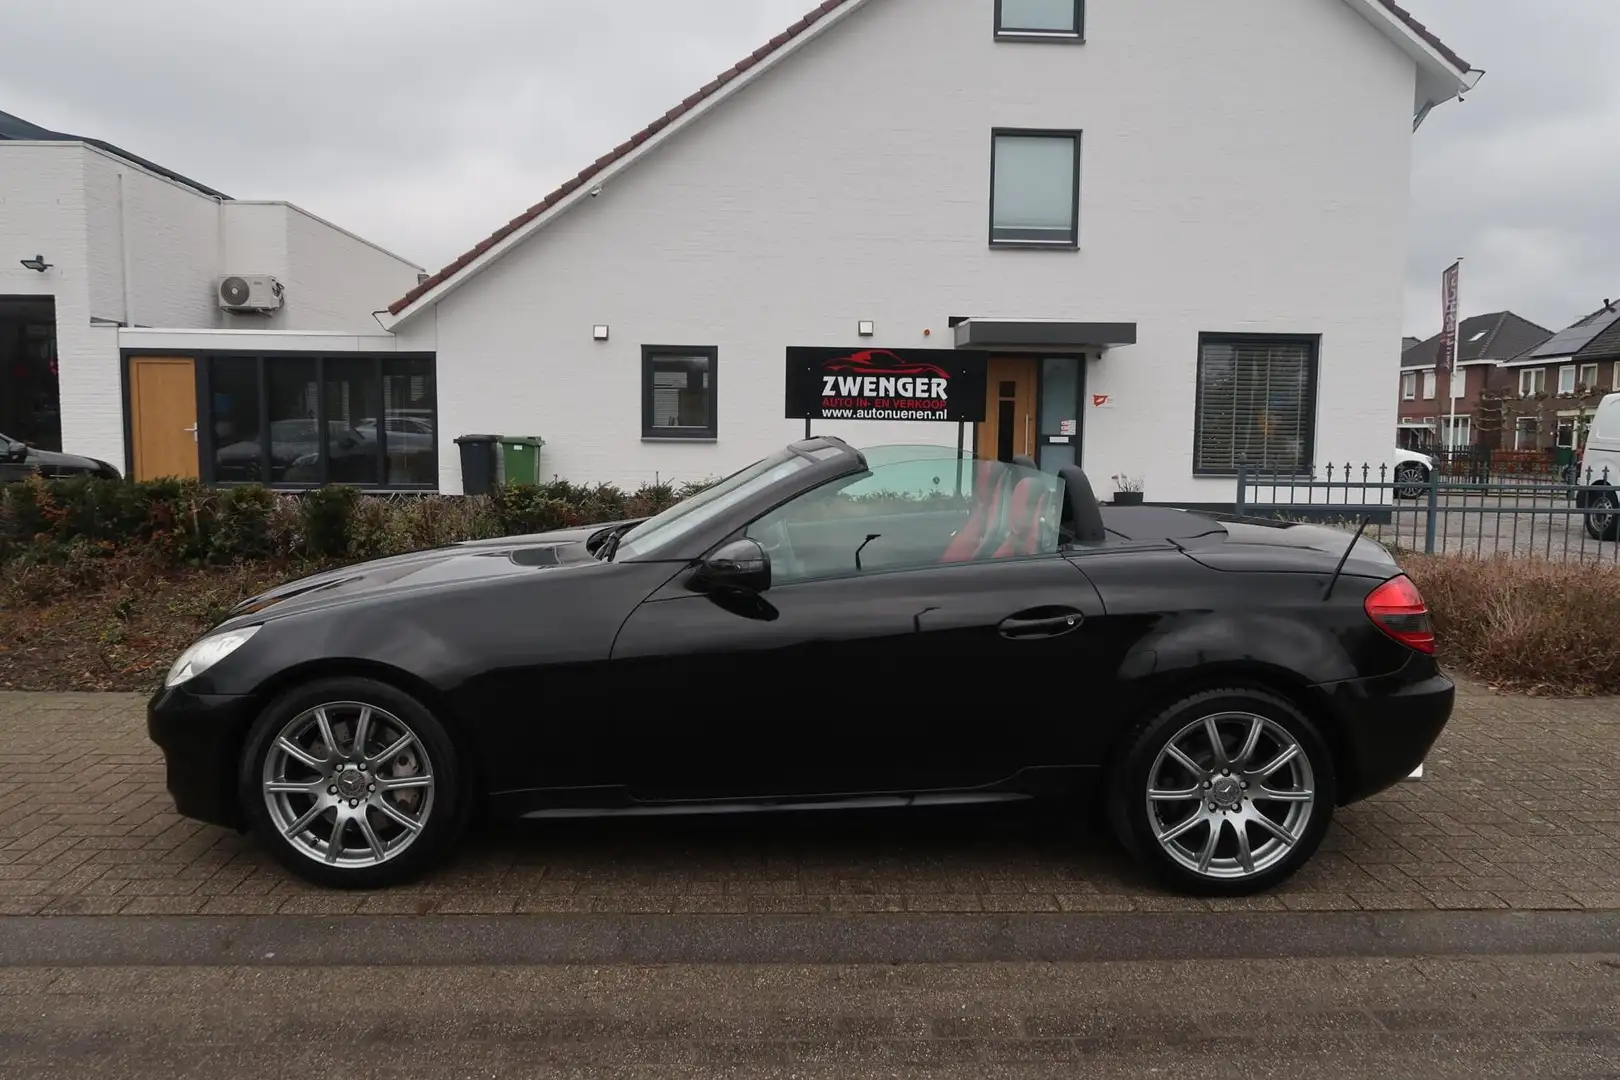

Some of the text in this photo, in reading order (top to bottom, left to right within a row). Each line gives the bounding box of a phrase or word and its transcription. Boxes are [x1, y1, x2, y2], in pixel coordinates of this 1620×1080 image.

[822, 376, 948, 400] ZWENGER
[823, 398, 947, 409] AUTO IN- EN VERKOOP
[822, 408, 947, 419] www.autonuenen.nl
